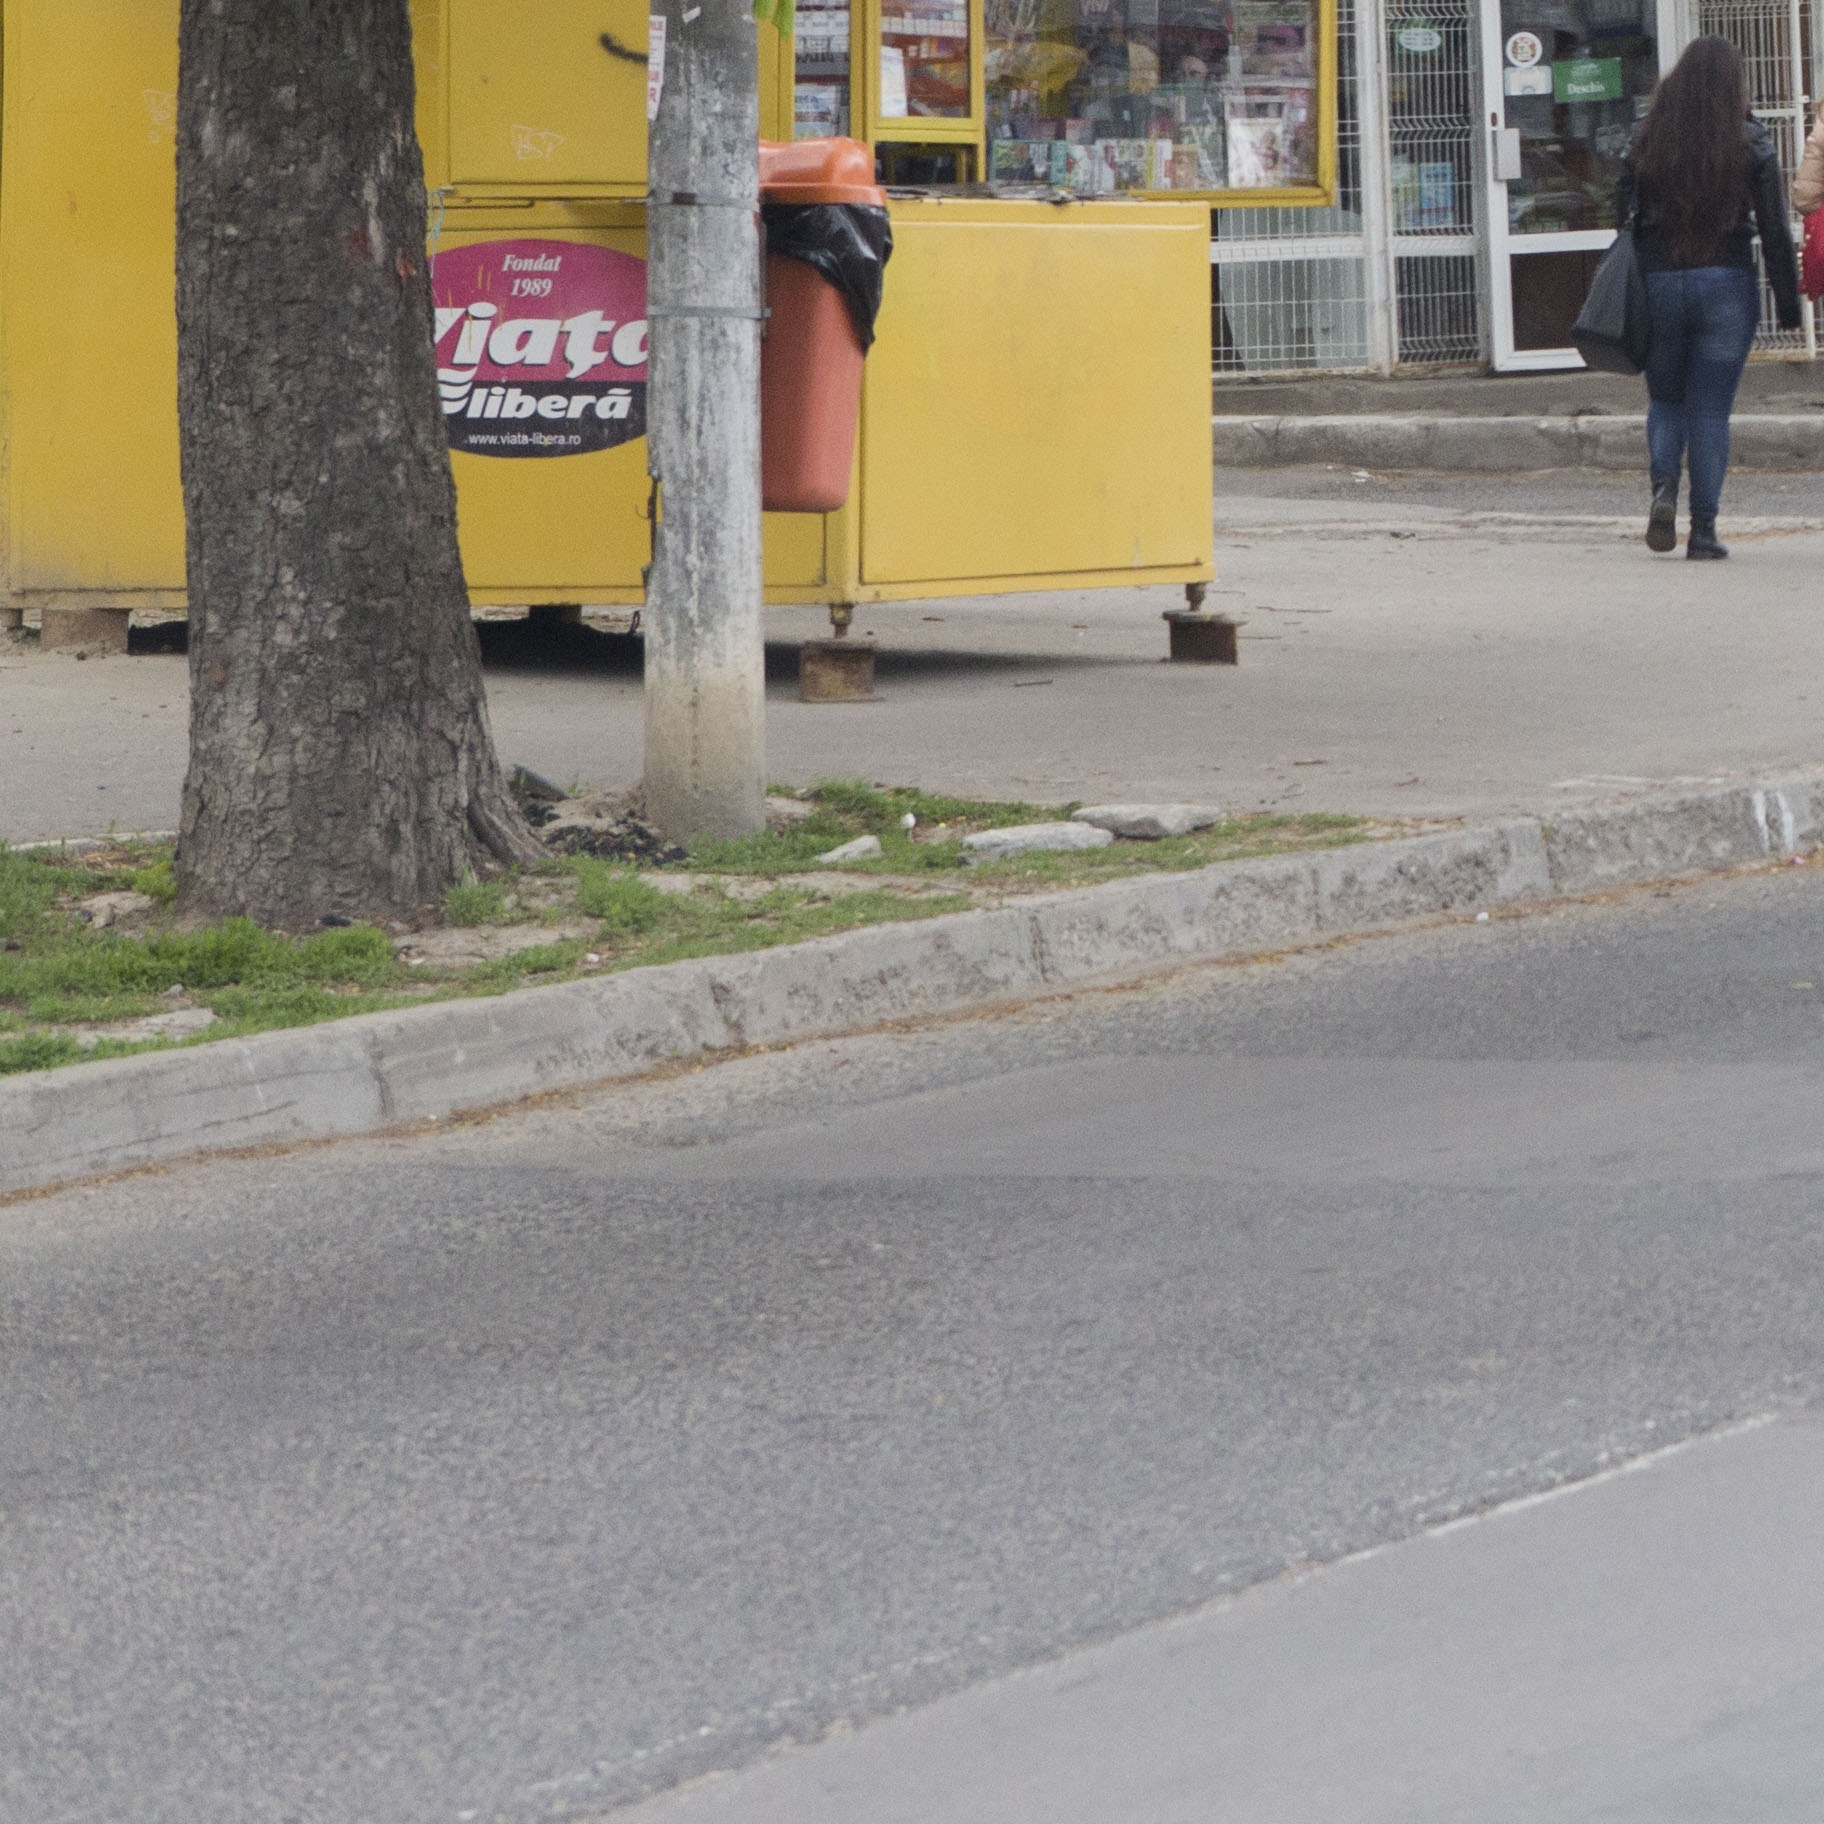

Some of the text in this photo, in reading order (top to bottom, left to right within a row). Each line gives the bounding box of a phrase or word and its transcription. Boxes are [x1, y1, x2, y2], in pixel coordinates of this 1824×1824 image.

[502, 253, 562, 272] Fondat
[511, 278, 553, 297] 1989
[466, 386, 632, 420] liberă
